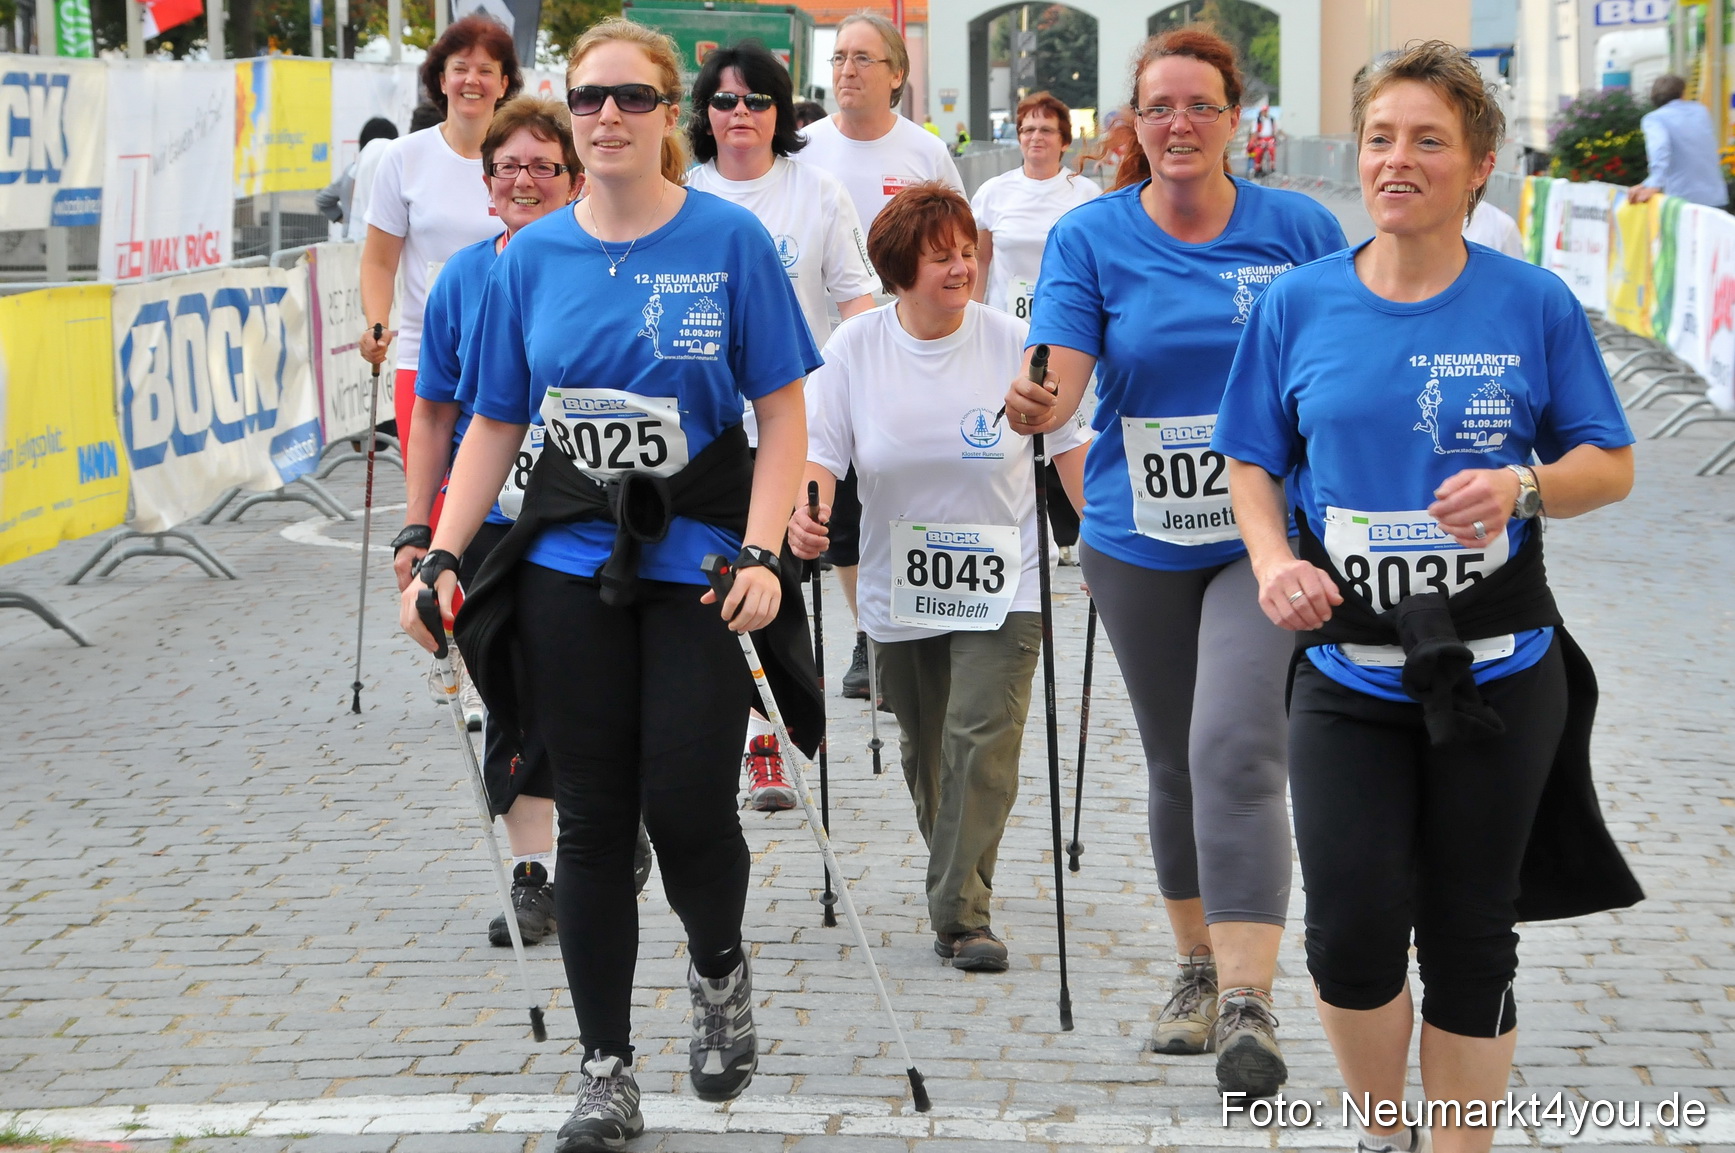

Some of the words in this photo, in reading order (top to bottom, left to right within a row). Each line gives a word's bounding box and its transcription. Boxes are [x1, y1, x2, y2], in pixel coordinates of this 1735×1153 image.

[1594, 0, 1667, 26] BO
[0, 72, 70, 184] CK
[634, 274, 653, 284] 12.
[655, 272, 728, 283] NEUMARKTR
[1219, 271, 1237, 280] 12.
[652, 283, 719, 293] STADTLAUF
[679, 329, 722, 338] 18.09.2011
[1409, 355, 1431, 367] 12.
[1434, 354, 1521, 367] NEUMARKTER
[120, 286, 288, 470] BOCK
[1430, 366, 1505, 377] STADTLAUF
[562, 397, 627, 411] BOCK
[1462, 419, 1512, 428] 18.09.2011
[552, 418, 668, 469] 8025
[1143, 450, 1229, 499] 802
[1162, 506, 1237, 530] Jeanett
[926, 531, 980, 544] BOCK
[1369, 522, 1451, 541] BOCK
[906, 549, 1005, 594] 8043
[915, 595, 989, 619] Elisabeth
